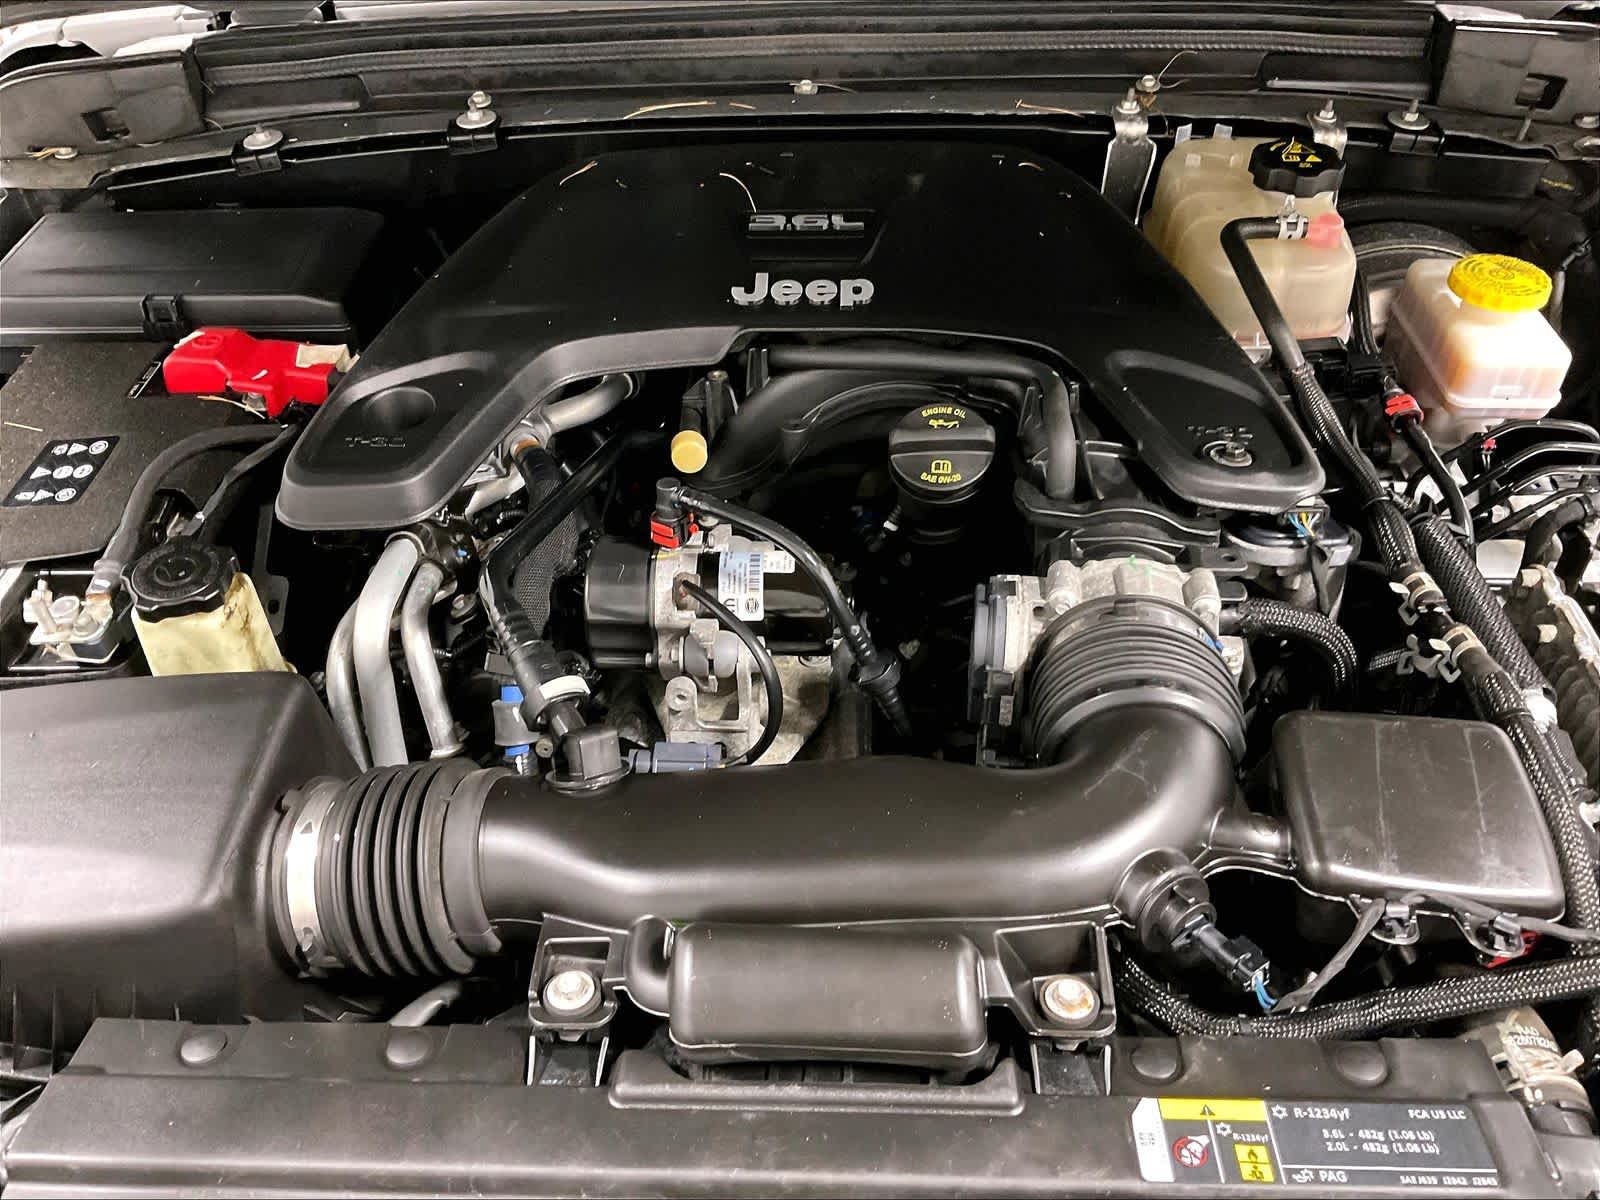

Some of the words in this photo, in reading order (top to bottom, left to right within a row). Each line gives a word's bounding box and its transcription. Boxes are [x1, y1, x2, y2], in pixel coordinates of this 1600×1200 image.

[748, 214, 865, 231] 3.6L
[731, 272, 875, 308] Jeep
[921, 406, 953, 418] ENGINE
[953, 408, 967, 419] OIL
[920, 472, 937, 483] SAE
[1293, 1107, 1350, 1121] R-1234yf
[1407, 1109, 1430, 1119] FCA
[1430, 1109, 1446, 1119] US
[1446, 1109, 1467, 1119] LLC
[1325, 1141, 1350, 1152] 2.0L
[1318, 1170, 1348, 1183] PAG
